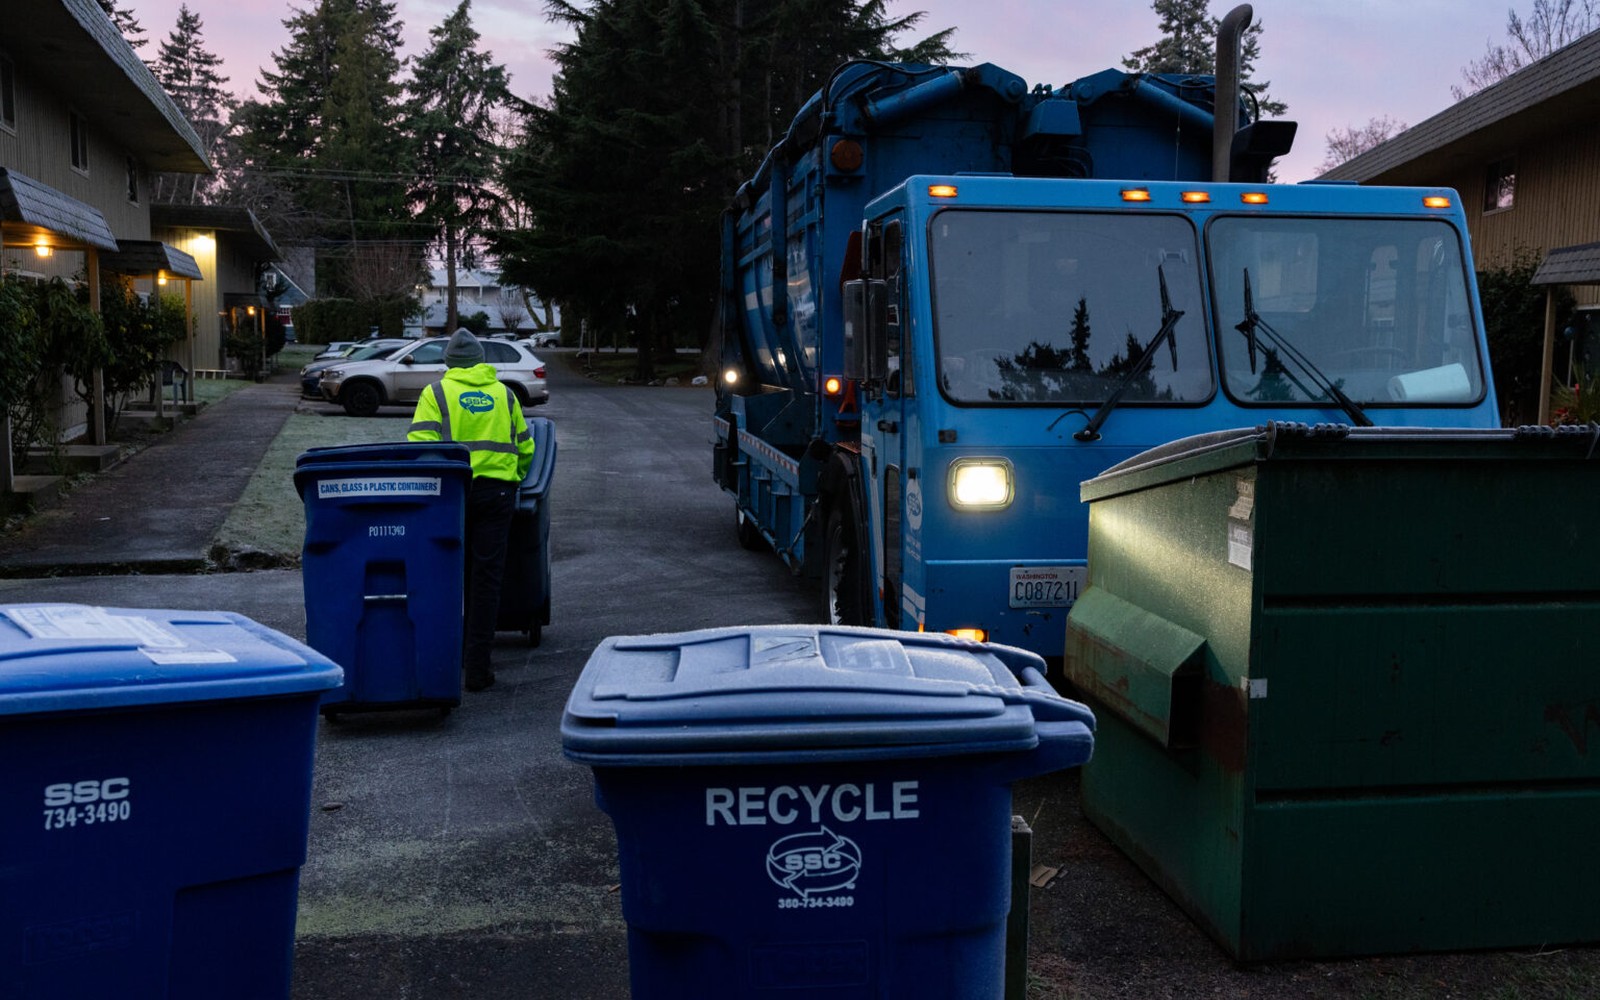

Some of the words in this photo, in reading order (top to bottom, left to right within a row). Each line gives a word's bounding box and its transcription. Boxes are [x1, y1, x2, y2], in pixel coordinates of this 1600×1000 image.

[320, 483, 341, 494] CANS,
[341, 483, 363, 492] GLASS
[363, 483, 369, 492] &
[369, 482, 396, 491] PLASTIC
[397, 482, 438, 491] CONTAINERS
[44, 777, 130, 807] SSC
[706, 780, 920, 826] RECYCLE
[43, 800, 131, 831] 734-3490
[784, 853, 842, 870] SSC
[777, 896, 855, 910] 360-734-3490
